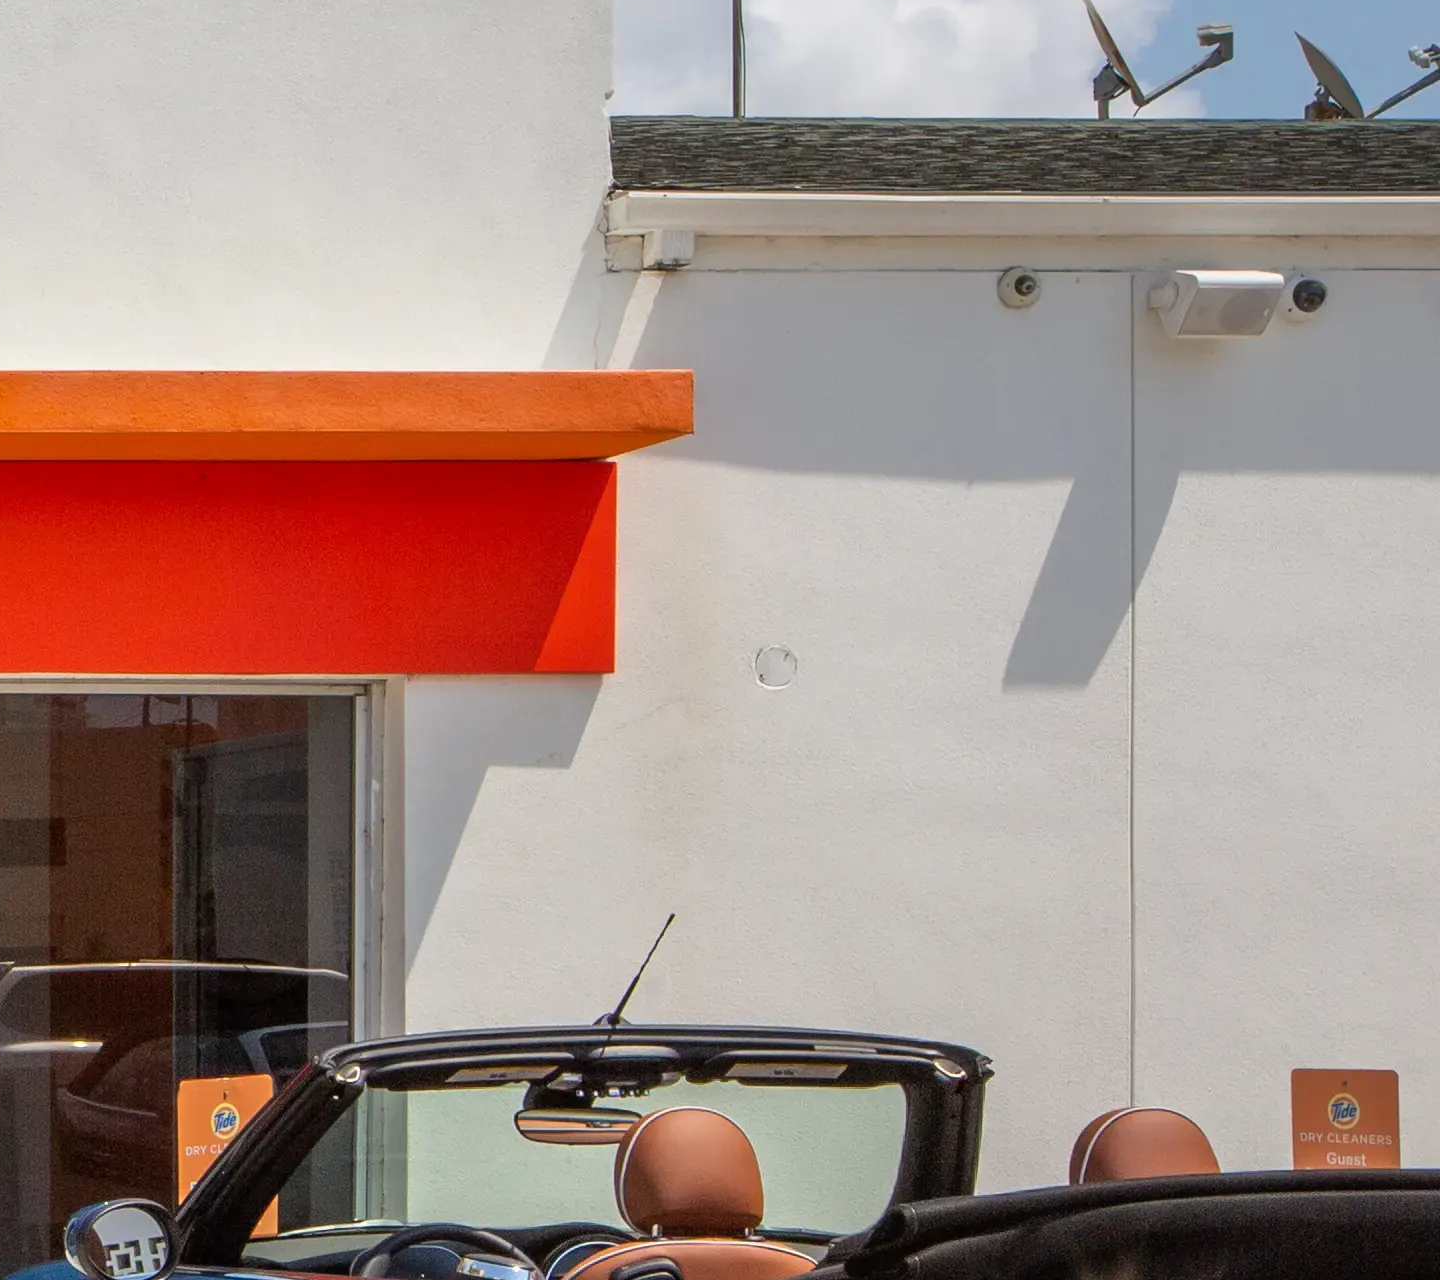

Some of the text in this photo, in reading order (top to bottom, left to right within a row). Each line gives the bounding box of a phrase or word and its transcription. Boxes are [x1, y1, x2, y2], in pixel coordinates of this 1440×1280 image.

[1331, 1102, 1358, 1123] Tide
[214, 1109, 237, 1133] Tide
[1300, 1132, 1393, 1145] DRY CLEANERS
[185, 1145, 207, 1156] DRY
[1326, 1151, 1367, 1167] Guest
